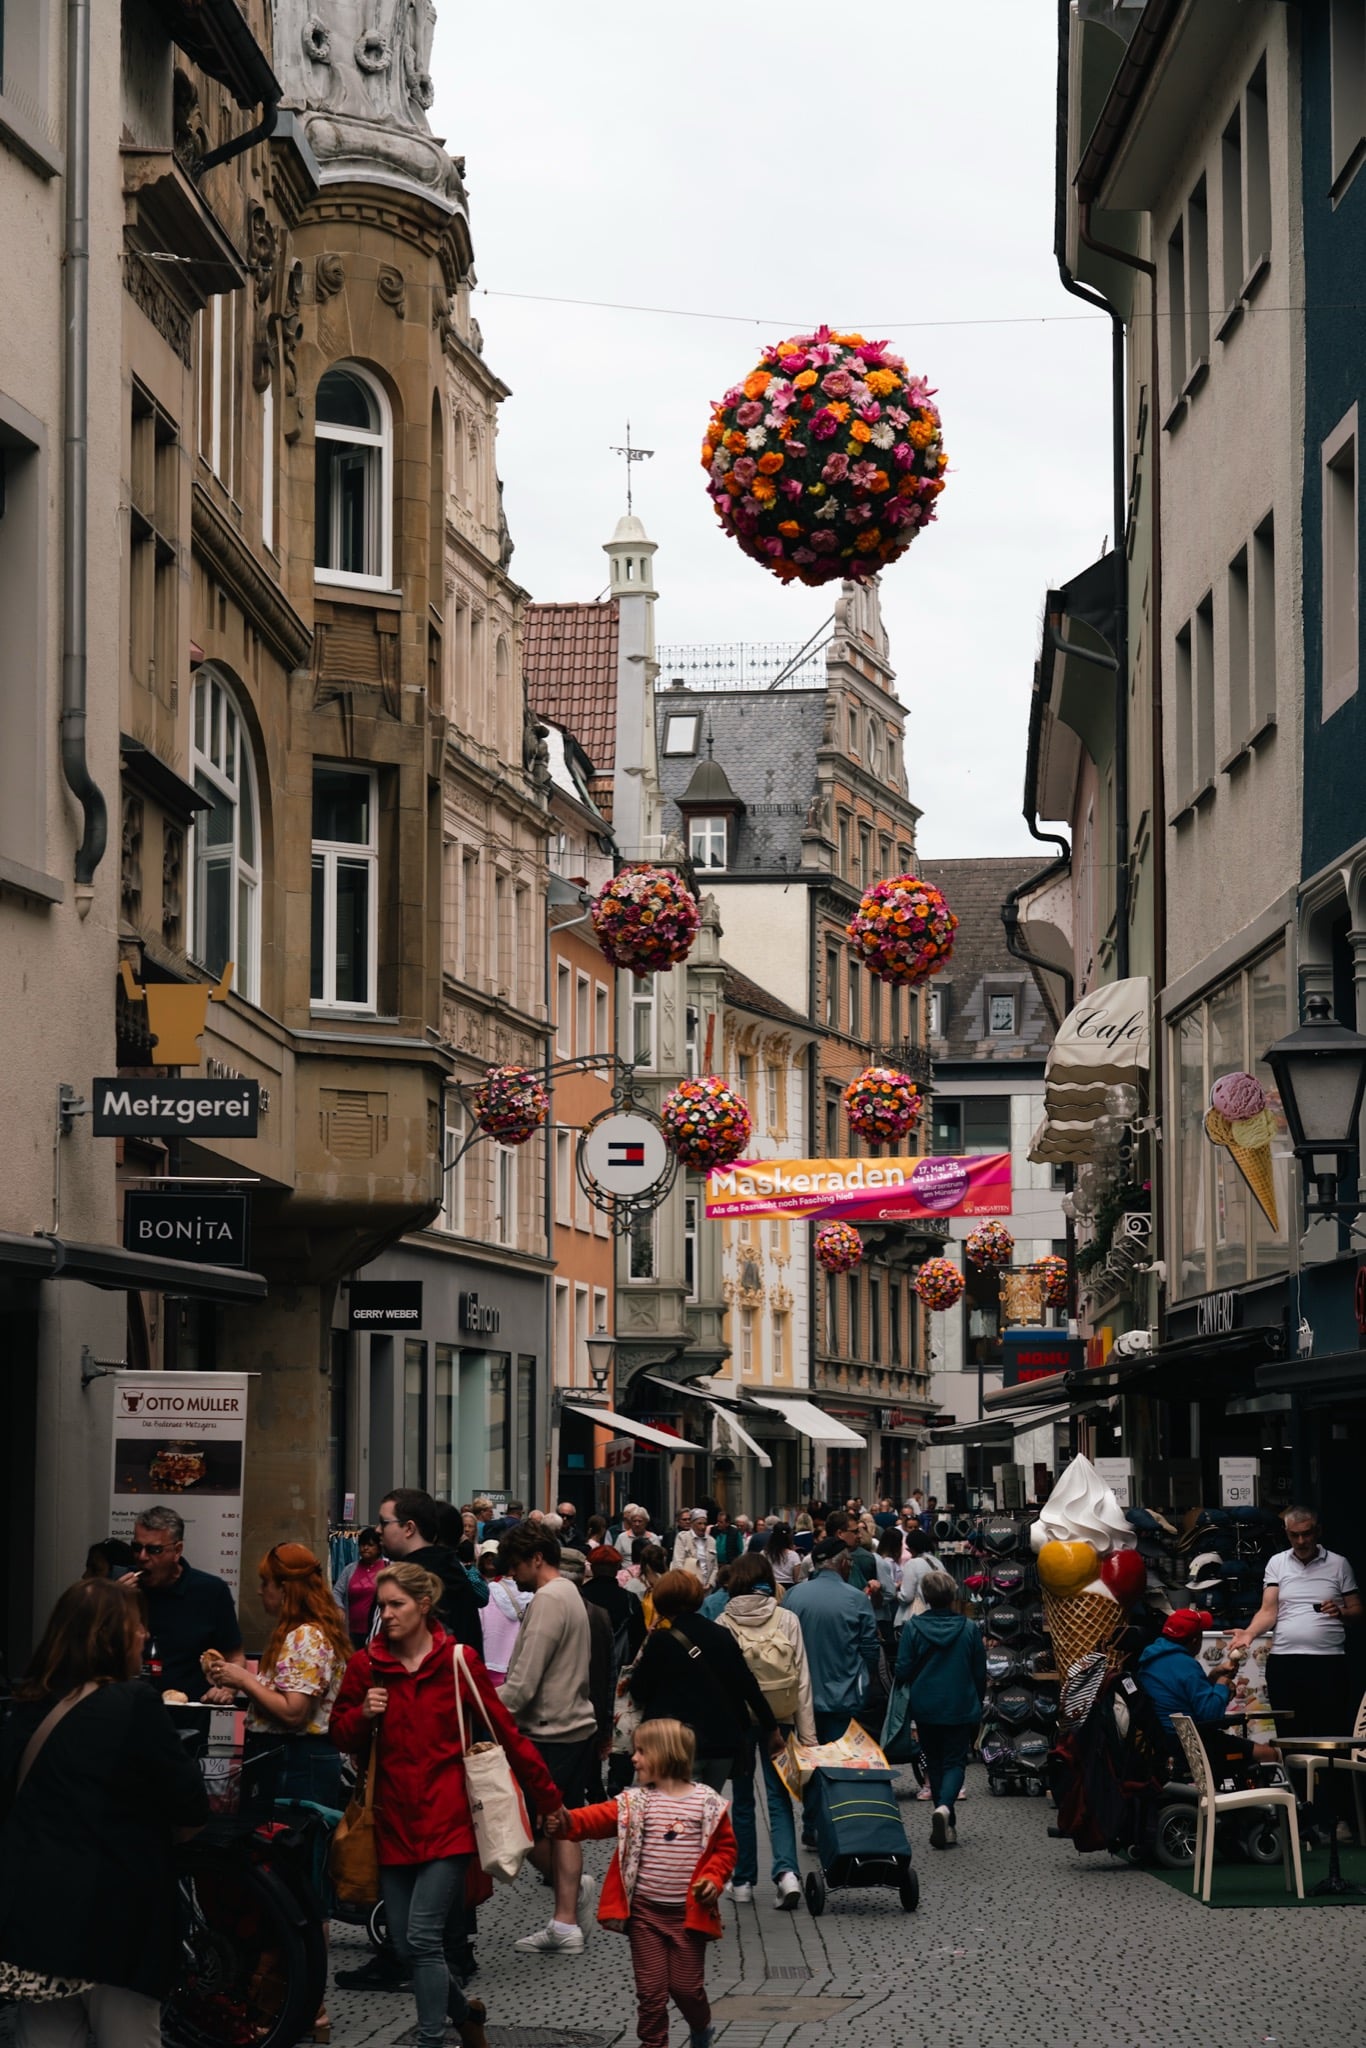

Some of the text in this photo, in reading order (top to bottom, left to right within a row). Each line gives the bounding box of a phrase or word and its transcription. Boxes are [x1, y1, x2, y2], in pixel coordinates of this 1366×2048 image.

[1075, 1007, 1145, 1048] Cafe
[102, 1091, 250, 1124] Metzgerei
[711, 1161, 905, 1197] Maskeraden
[912, 1175, 925, 1184] bis
[937, 1172, 953, 1180] Jan
[918, 1166, 929, 1174] 17.
[930, 1164, 945, 1173] Mai
[712, 1204, 726, 1214] Als
[727, 1202, 738, 1213] die
[740, 1200, 777, 1212] Fasnacht
[778, 1198, 798, 1208] noch
[799, 1194, 835, 1206] Fasching
[353, 1309, 418, 1319] GERRY WEBER
[1197, 1289, 1234, 1335] CANVERO
[146, 1396, 239, 1411] OTTO MÜLLER
[605, 1446, 632, 1469] EIS
